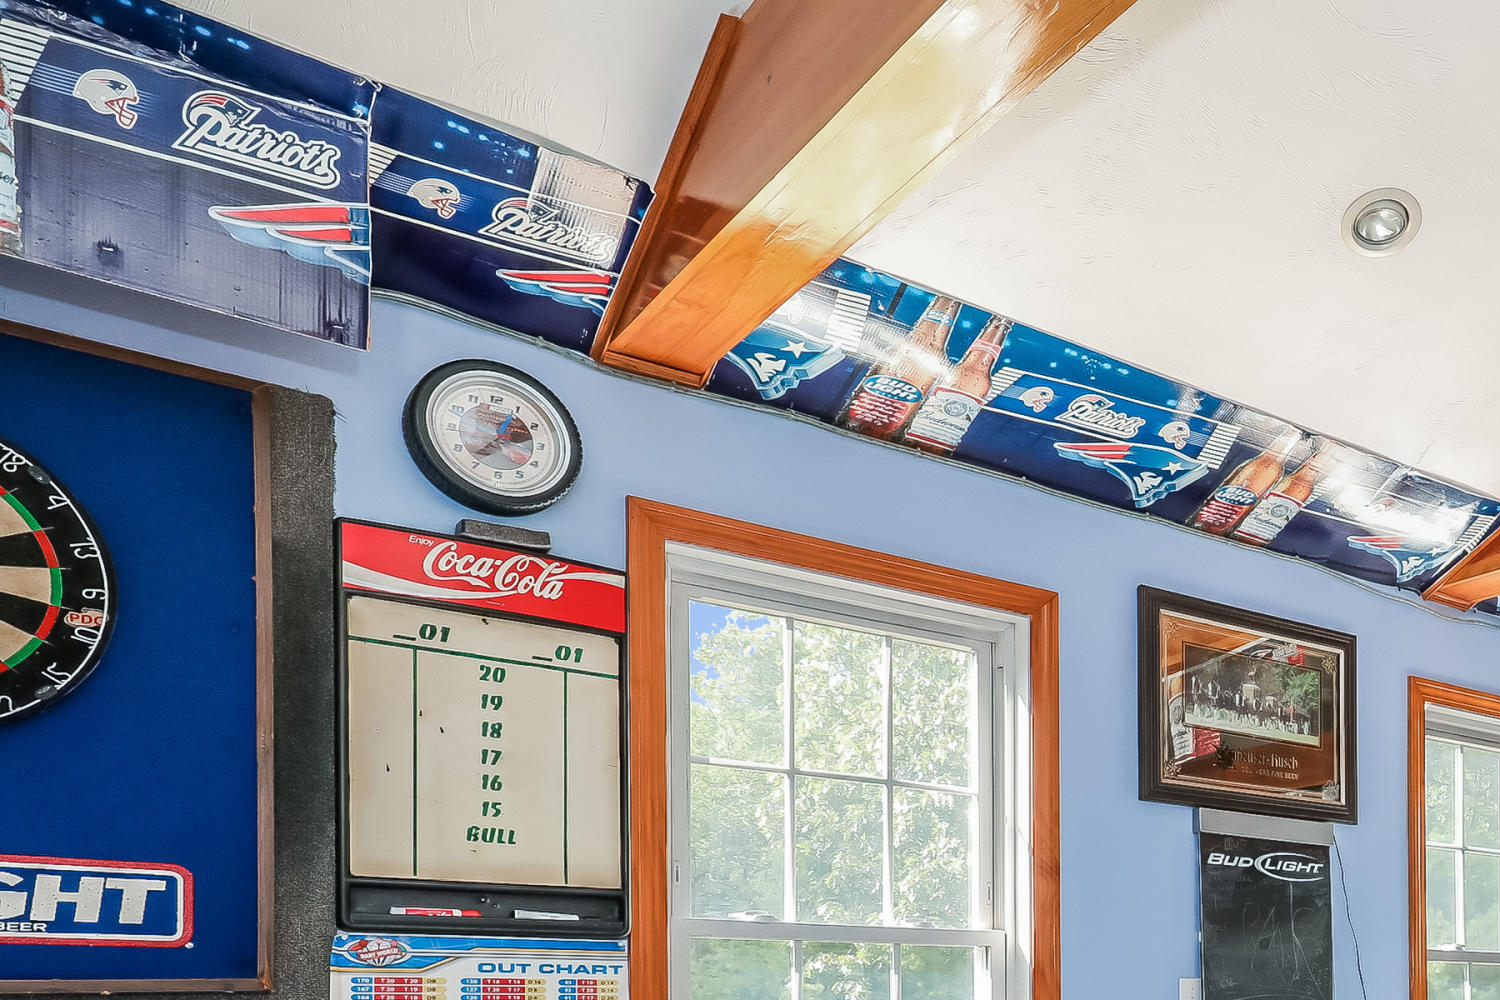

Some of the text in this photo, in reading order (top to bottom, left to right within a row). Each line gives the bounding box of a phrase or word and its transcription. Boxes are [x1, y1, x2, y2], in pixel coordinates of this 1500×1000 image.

[173, 113, 340, 188] Patriots
[478, 205, 617, 262] Patriots
[875, 377, 917, 393] BUD
[489, 395, 504, 404] 12
[530, 422, 539, 431] 2
[1061, 400, 1146, 438] Patriots
[453, 443, 463, 452] 8
[536, 442, 545, 451] 3
[471, 461, 481, 470] 7
[529, 460, 540, 469] 4
[494, 471, 503, 479] 6
[515, 470, 525, 479] 5
[1217, 490, 1254, 504] LIGHT
[1226, 487, 1255, 499] BUD
[47, 494, 70, 510] 4
[408, 534, 435, 548] Enjoy
[423, 541, 569, 600] Coca-Cola
[479, 665, 506, 683] 20
[481, 694, 503, 711] 19
[481, 721, 503, 739] 18
[481, 749, 503, 766] 17
[481, 774, 503, 791] 16
[482, 801, 503, 818] 15
[466, 826, 517, 845] BULL
[1207, 852, 1324, 874] BUD LIGHT
[478, 963, 623, 975] OUT CHART
